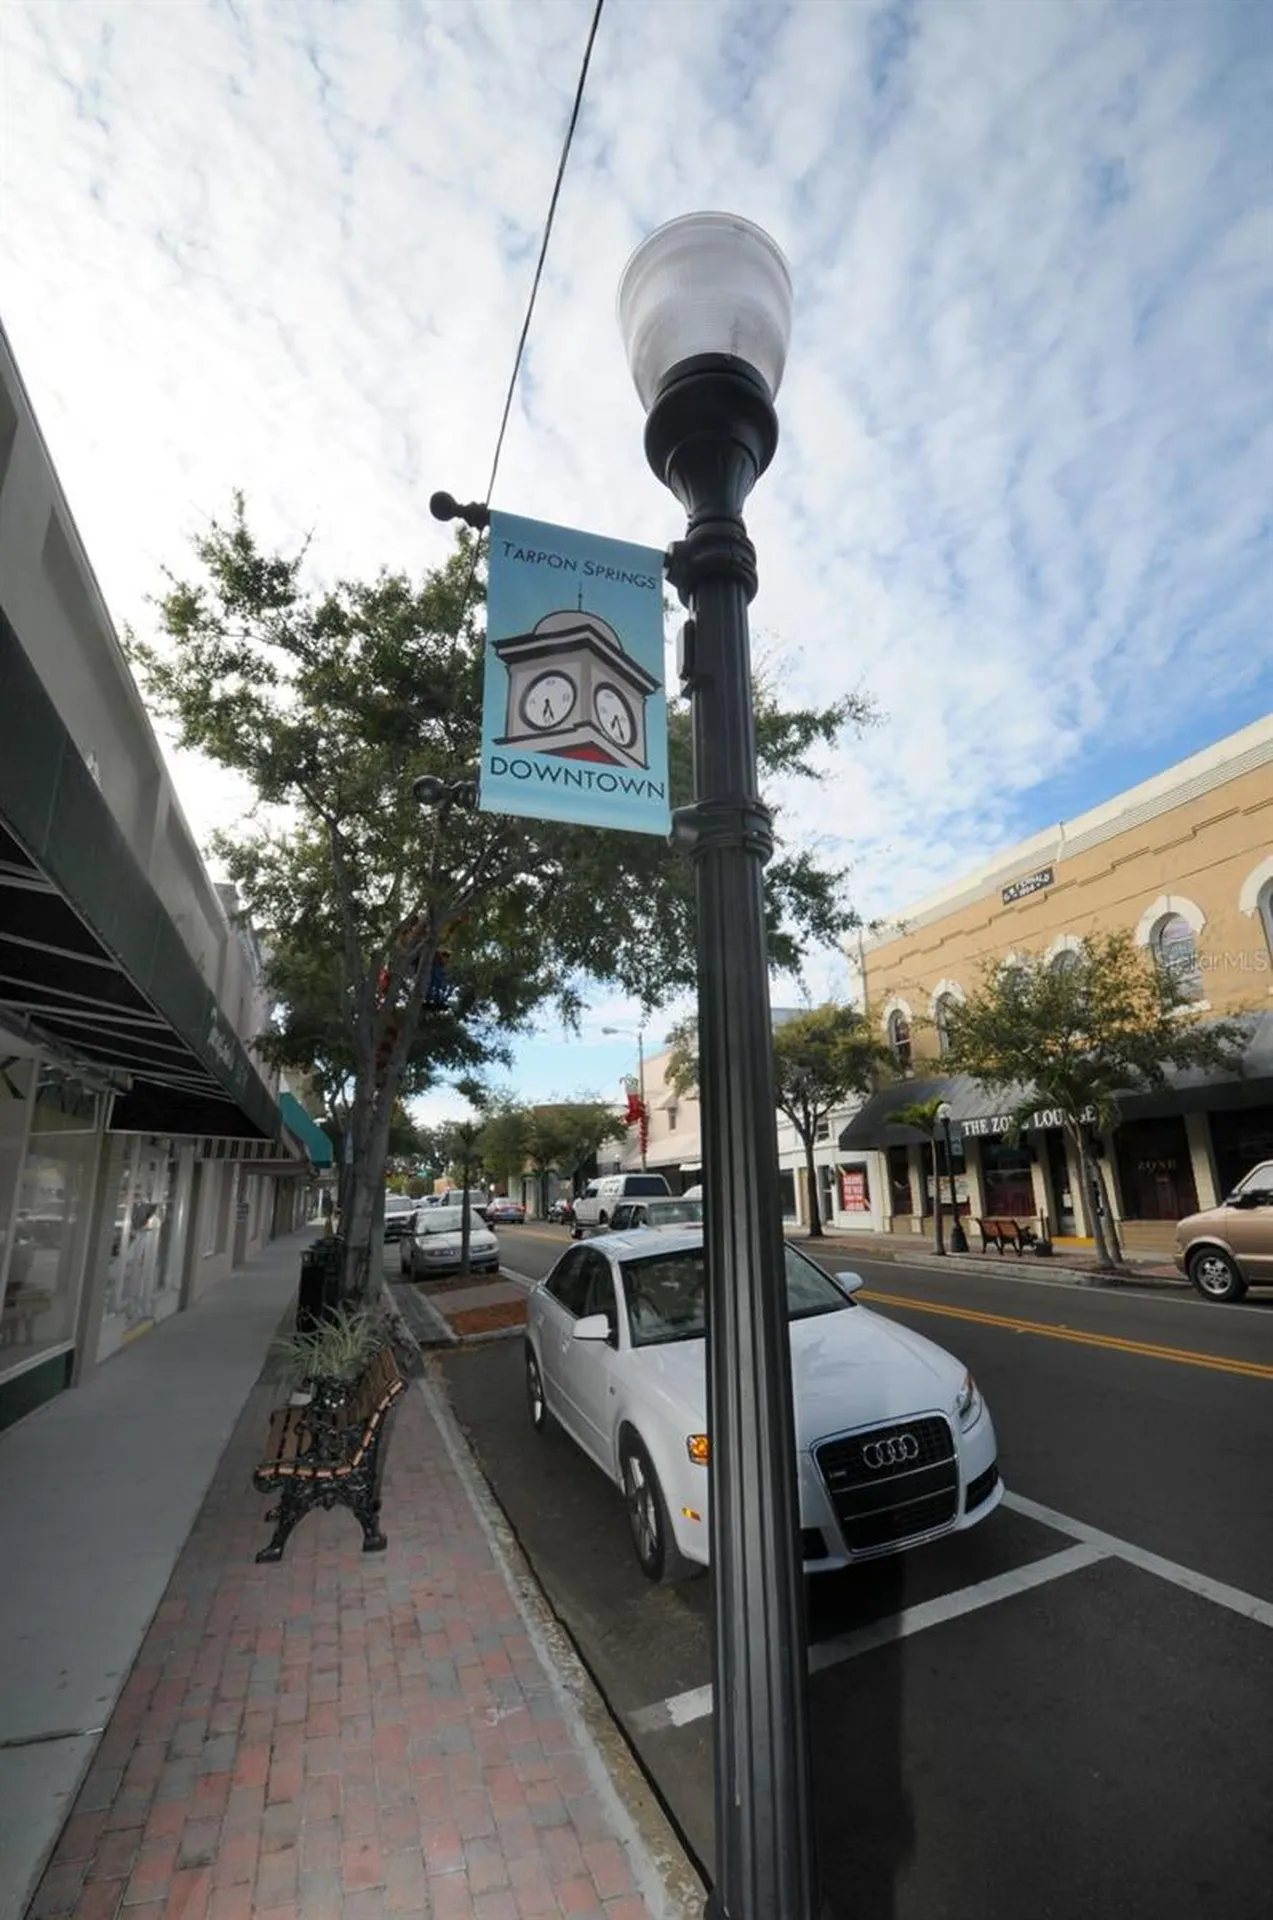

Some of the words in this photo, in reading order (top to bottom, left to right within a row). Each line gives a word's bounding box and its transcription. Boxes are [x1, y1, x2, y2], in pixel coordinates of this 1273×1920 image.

[502, 541, 577, 572] TARPON
[583, 560, 657, 590] SPRINGS
[490, 756, 664, 800] DOWNTOWN
[962, 1119, 988, 1136] THE
[992, 1115, 1030, 1132] ZO
